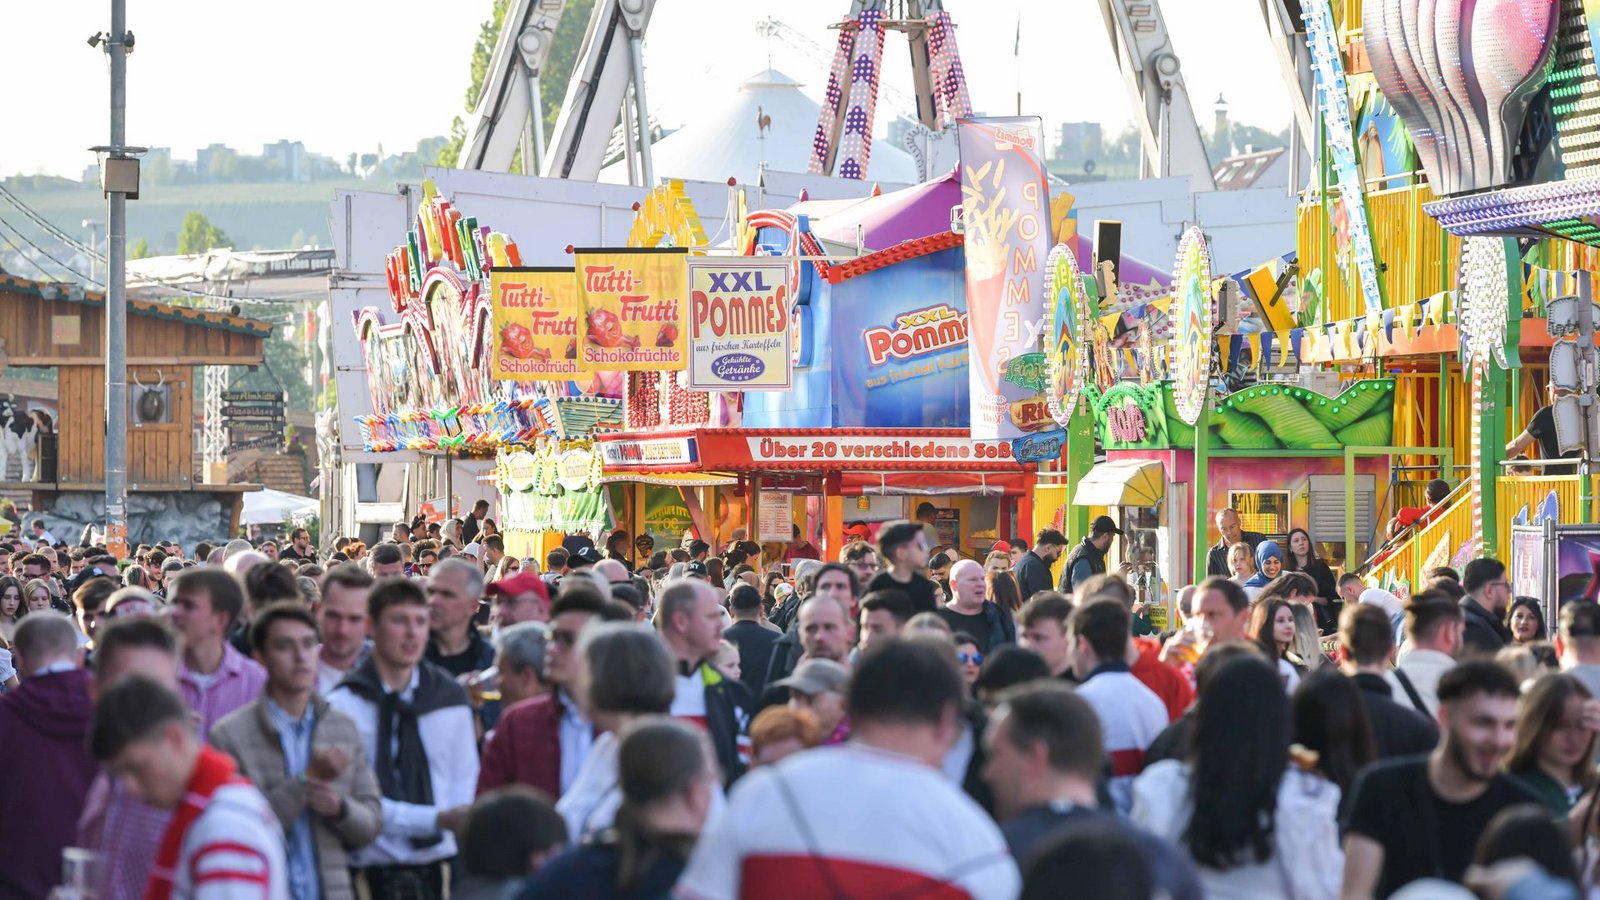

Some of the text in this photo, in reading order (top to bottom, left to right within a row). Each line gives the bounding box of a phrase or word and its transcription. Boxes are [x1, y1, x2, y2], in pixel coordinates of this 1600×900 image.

[585, 265, 641, 292] Tutti-
[708, 271, 771, 292] XXL
[500, 283, 552, 308] Tutti-
[620, 295, 679, 321] Frutti
[901, 308, 955, 330] XXL
[585, 347, 679, 362] Schokofrüchte
[696, 338, 782, 354] aus frischen Kartoffeln
[500, 359, 587, 374] Schokofrüch
[717, 364, 761, 377] Getränke
[722, 355, 752, 366] Gekühlte
[760, 438, 1016, 459] Über 20 verschiedene Soß
